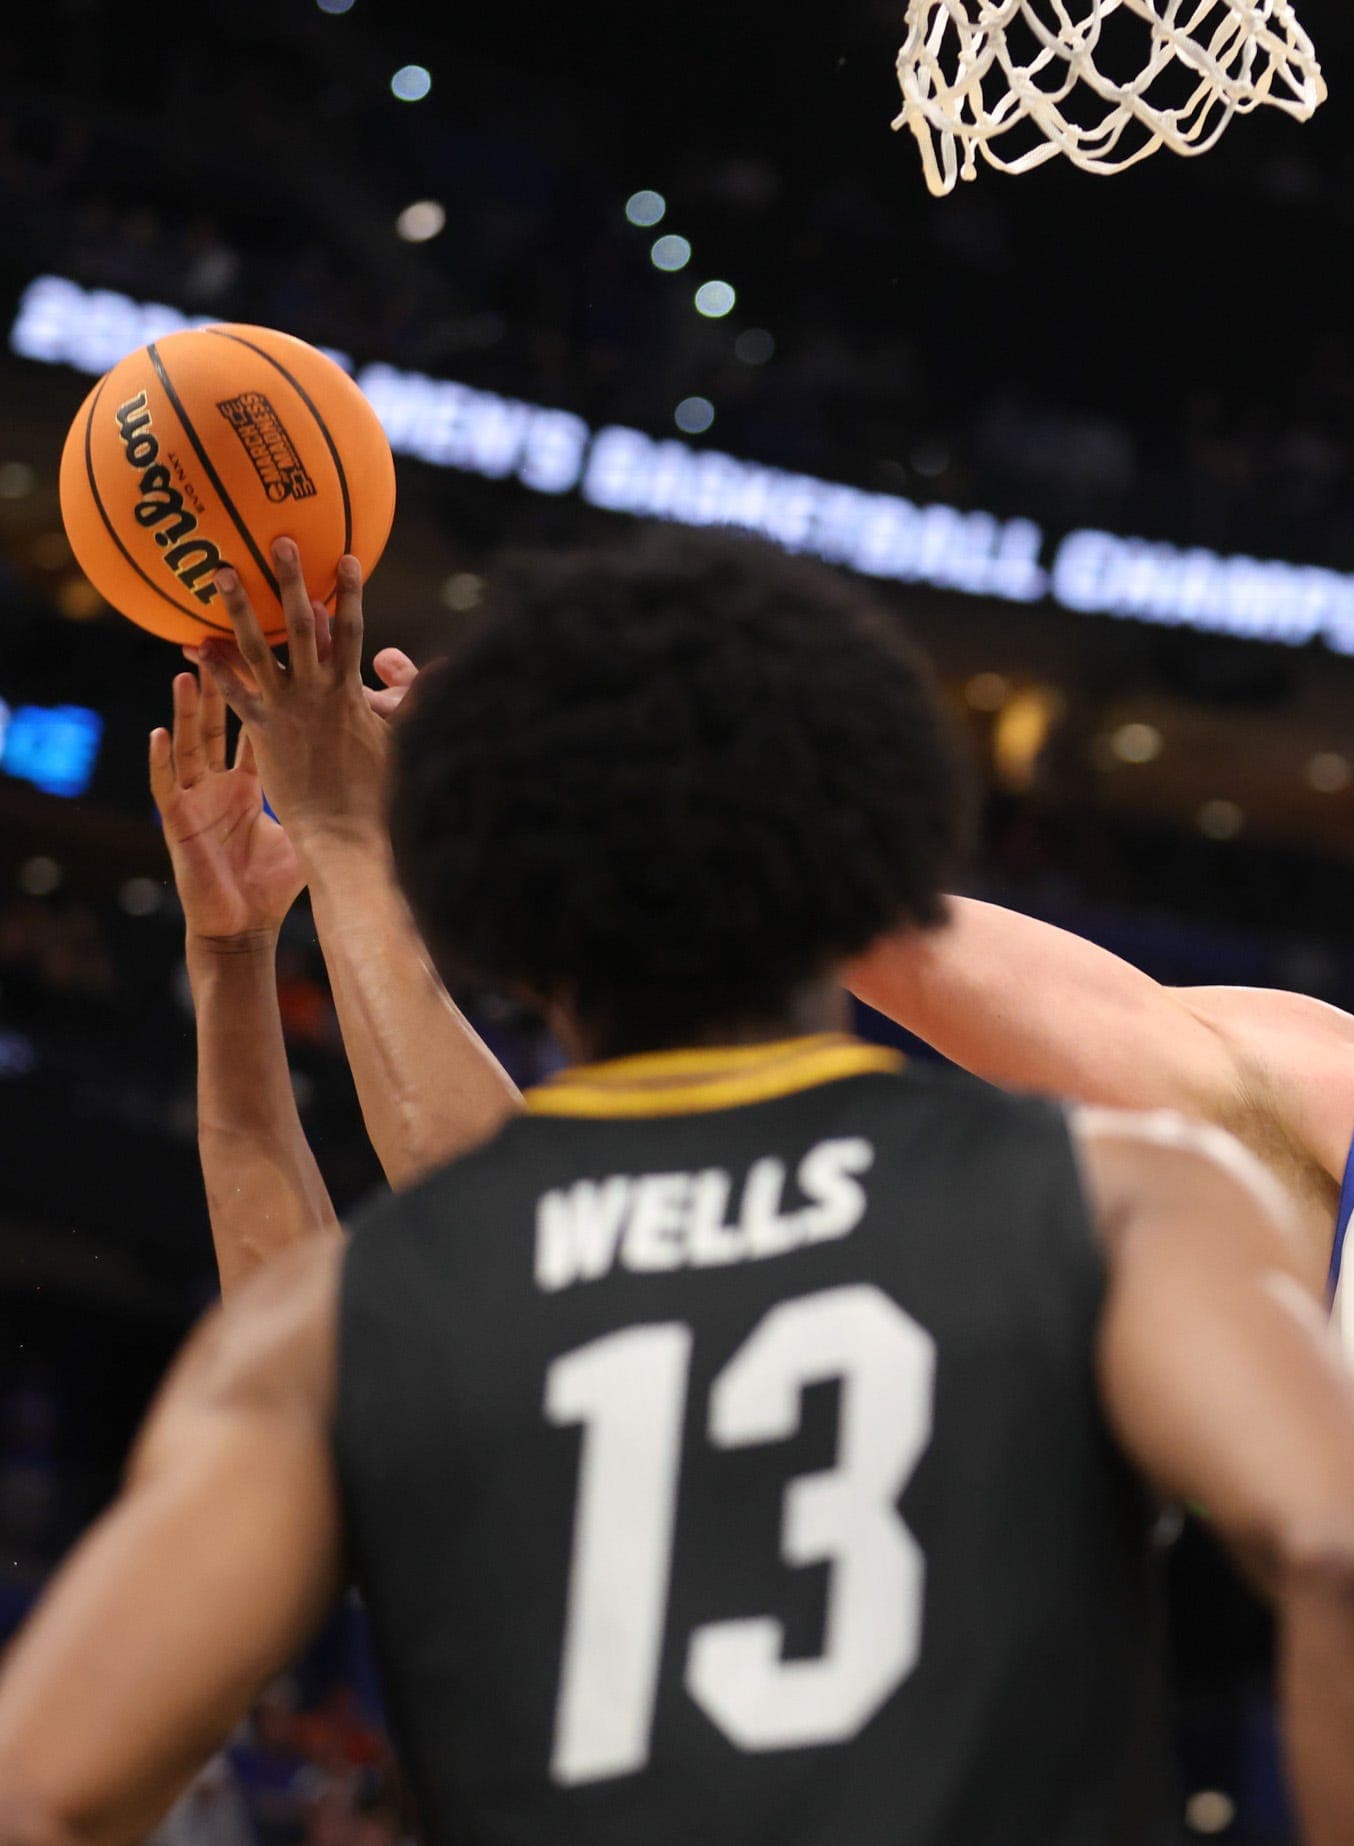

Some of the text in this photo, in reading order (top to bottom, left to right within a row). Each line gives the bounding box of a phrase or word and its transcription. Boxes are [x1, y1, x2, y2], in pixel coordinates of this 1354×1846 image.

[115, 389, 234, 605] Wilson
[239, 423, 284, 484] MARCH
[534, 1136, 875, 1292] WELLS
[544, 1282, 937, 1786] 13
